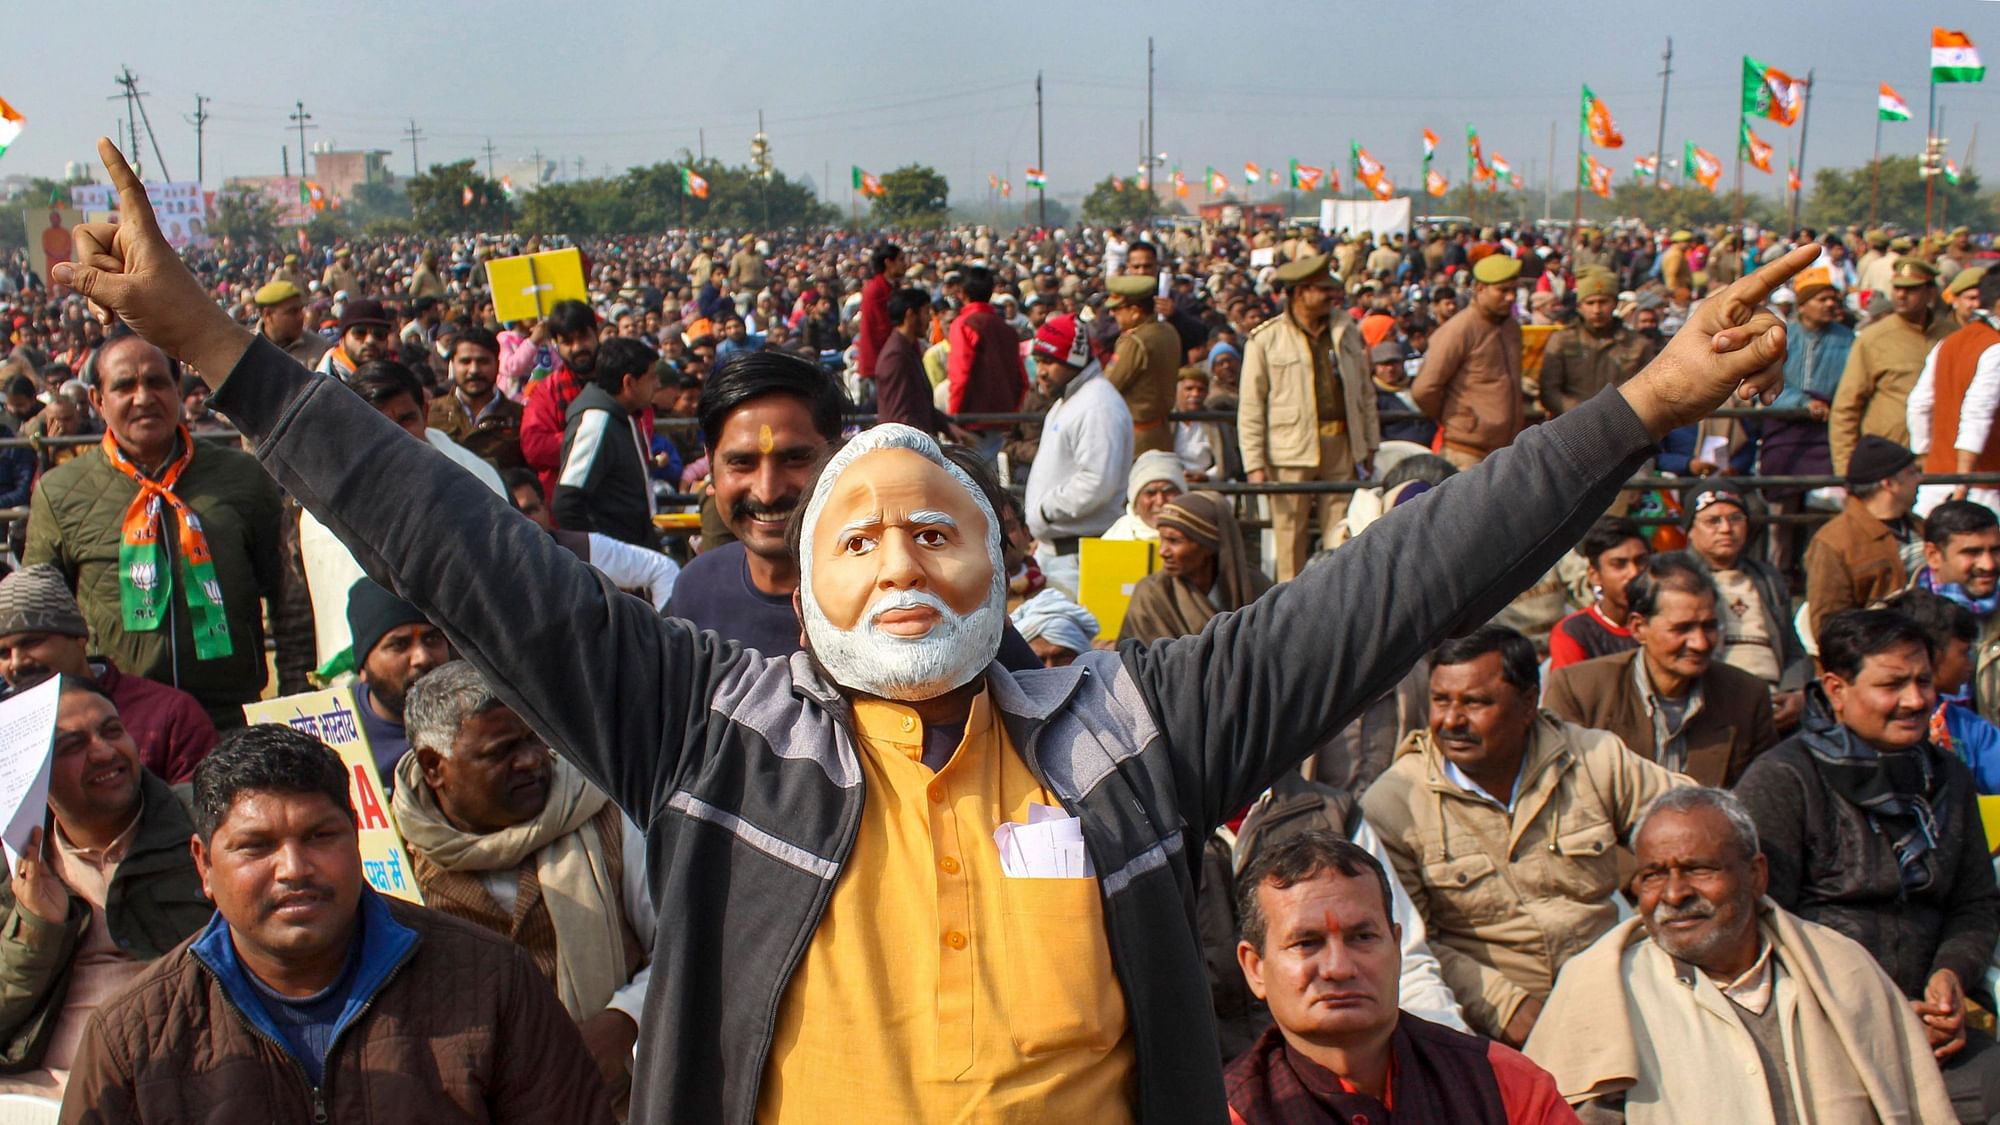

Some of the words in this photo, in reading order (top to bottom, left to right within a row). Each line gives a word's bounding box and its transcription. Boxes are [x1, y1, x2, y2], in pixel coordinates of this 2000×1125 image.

[318, 696, 360, 744] भारतीय
[363, 860, 392, 891] पक्ष
[386, 848, 408, 891] में
